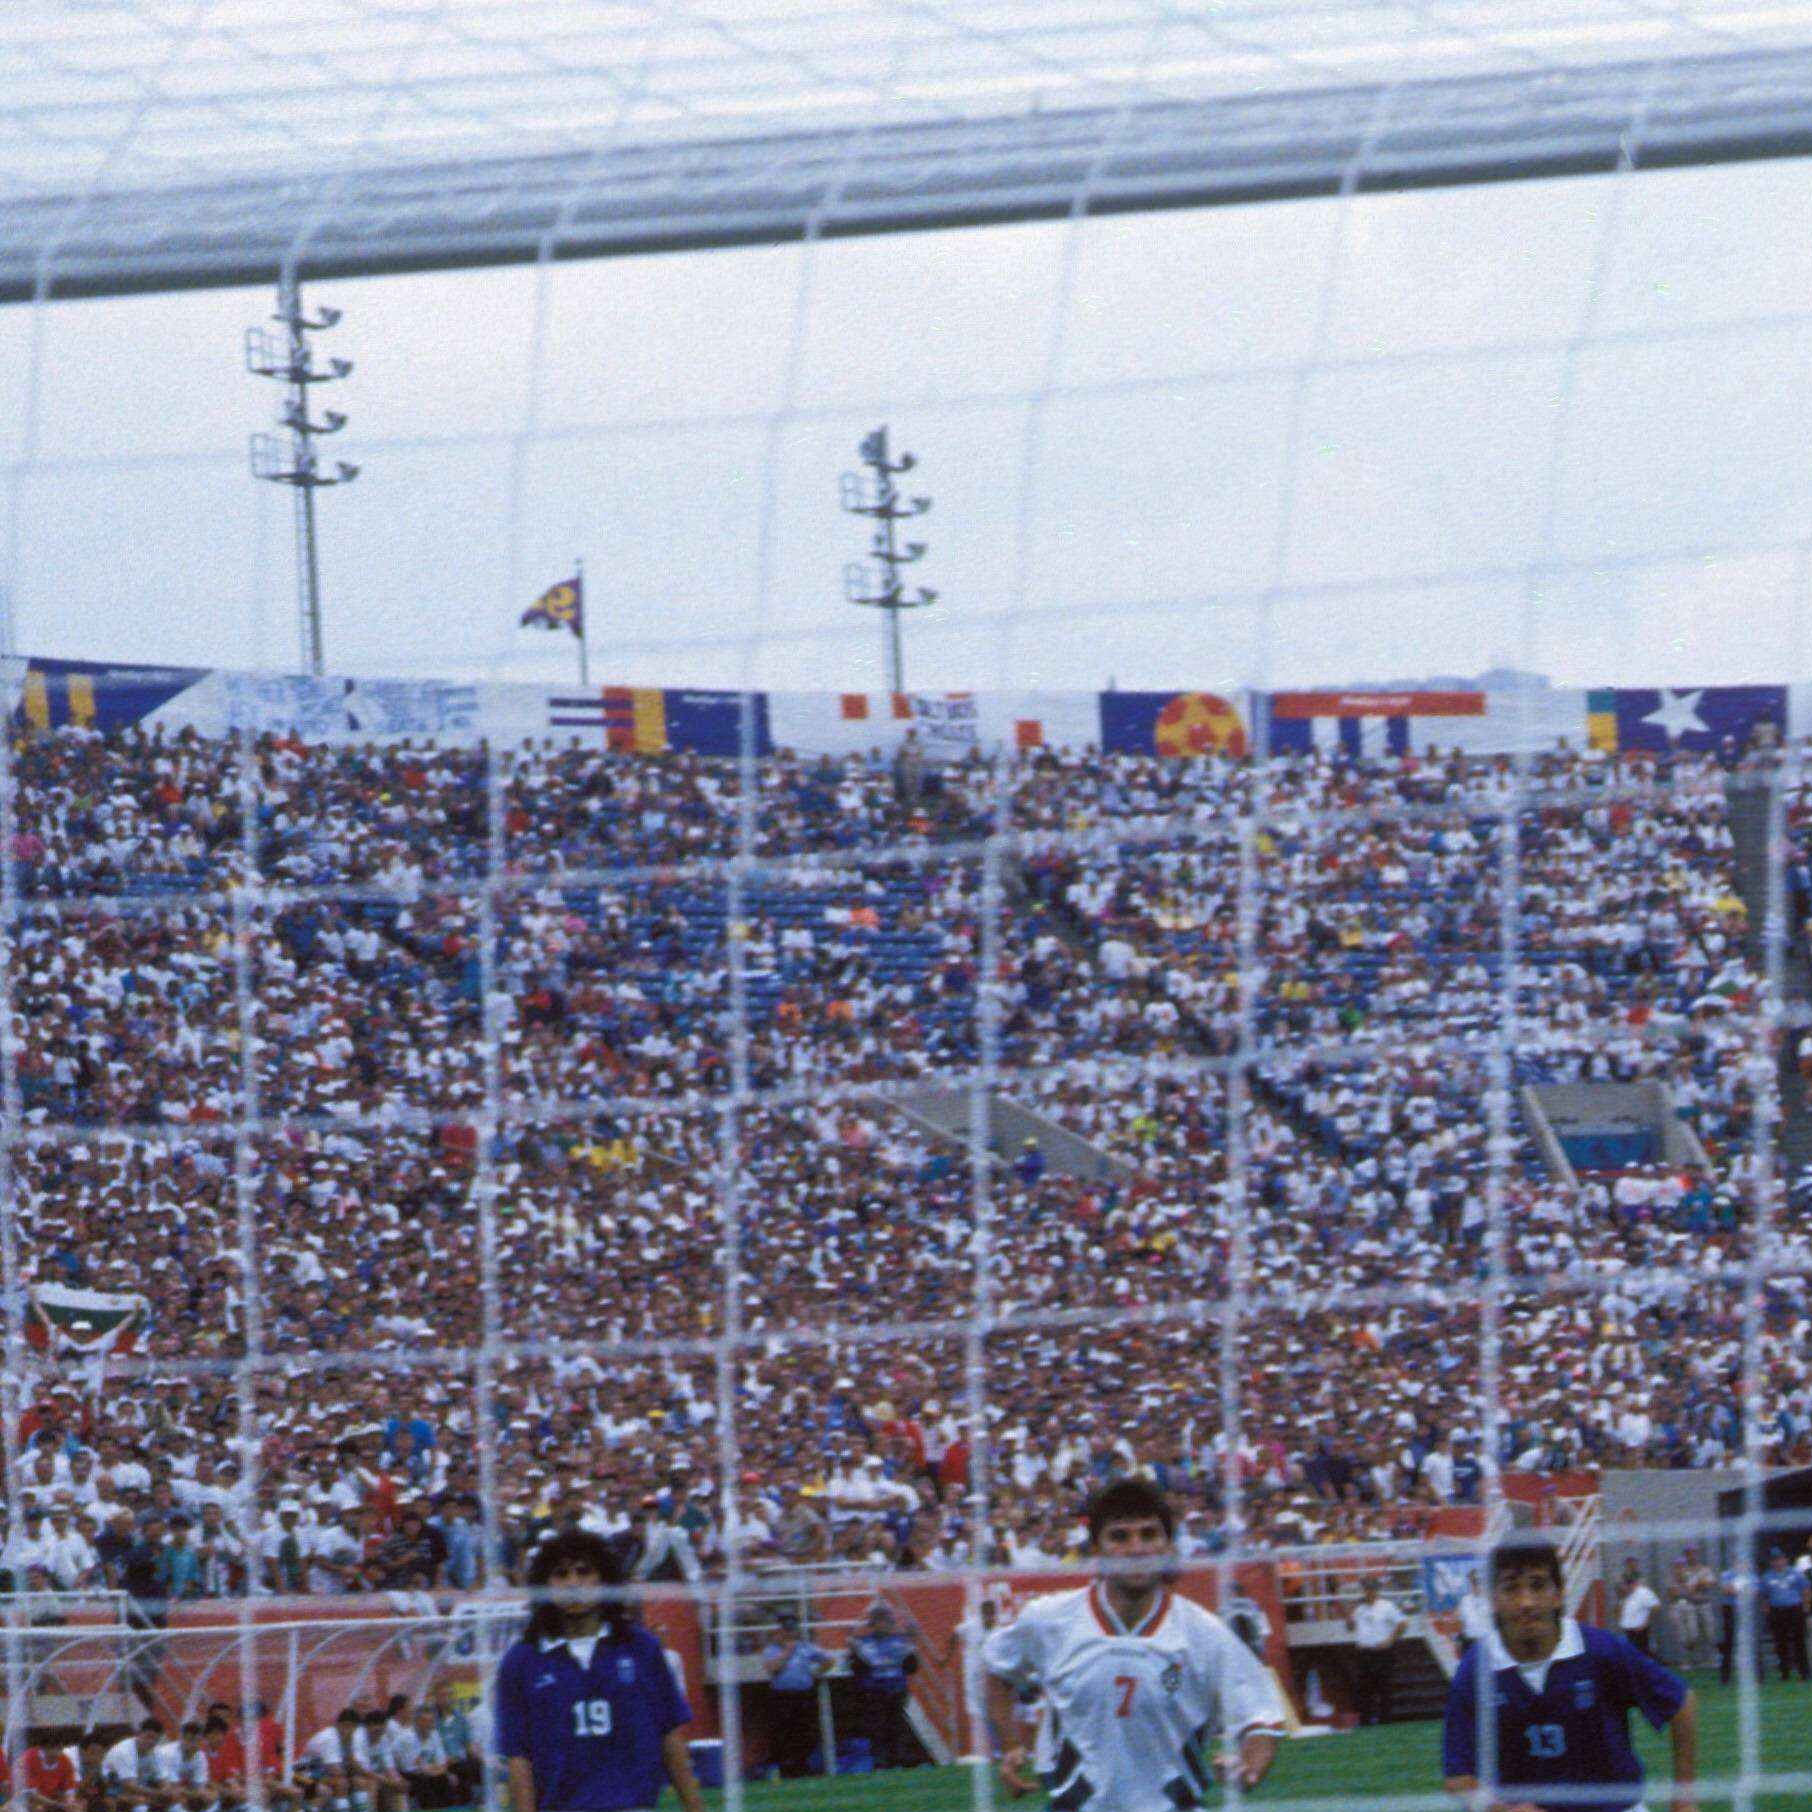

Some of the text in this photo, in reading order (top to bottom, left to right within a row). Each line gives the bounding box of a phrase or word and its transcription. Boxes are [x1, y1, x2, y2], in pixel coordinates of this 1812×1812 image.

[1114, 1675, 1139, 1718] 7
[572, 1698, 613, 1737] 19
[1523, 1722, 1567, 1759] 13
